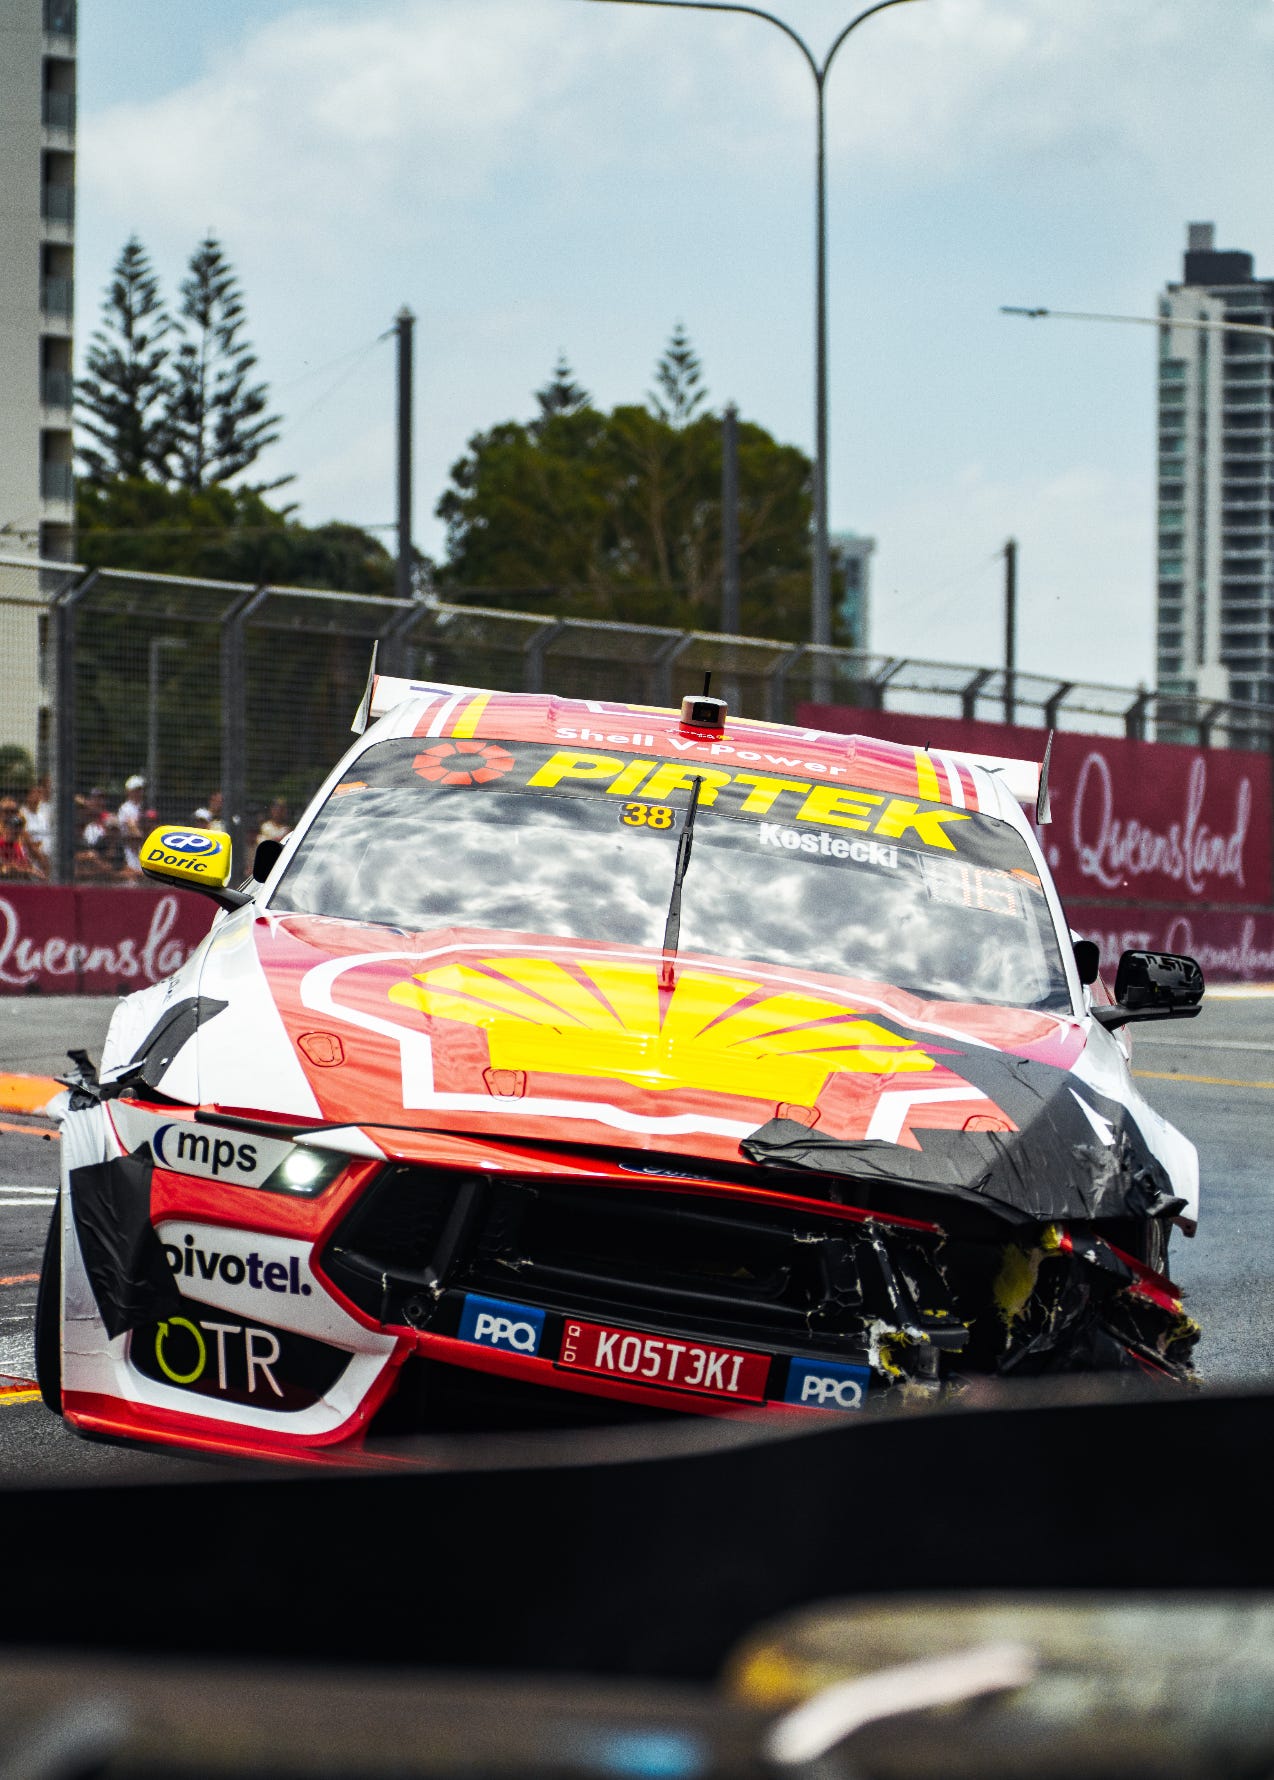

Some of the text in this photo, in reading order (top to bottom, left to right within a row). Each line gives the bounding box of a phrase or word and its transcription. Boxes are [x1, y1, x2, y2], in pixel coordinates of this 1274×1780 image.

[555, 727, 654, 747] Shell
[667, 738, 847, 776] V-Power
[527, 751, 969, 851] PIRTEK
[621, 803, 674, 829] 38
[1072, 752, 1250, 894] Queensland
[147, 849, 208, 872] Doric
[759, 821, 900, 869] Kostecki
[177, 1131, 258, 1175] mps
[163, 1233, 312, 1296] pivotel.
[474, 1313, 537, 1352] PPQ
[562, 1325, 582, 1362] QLD
[155, 1316, 284, 1397] OTR
[800, 1374, 863, 1408] PPQ
